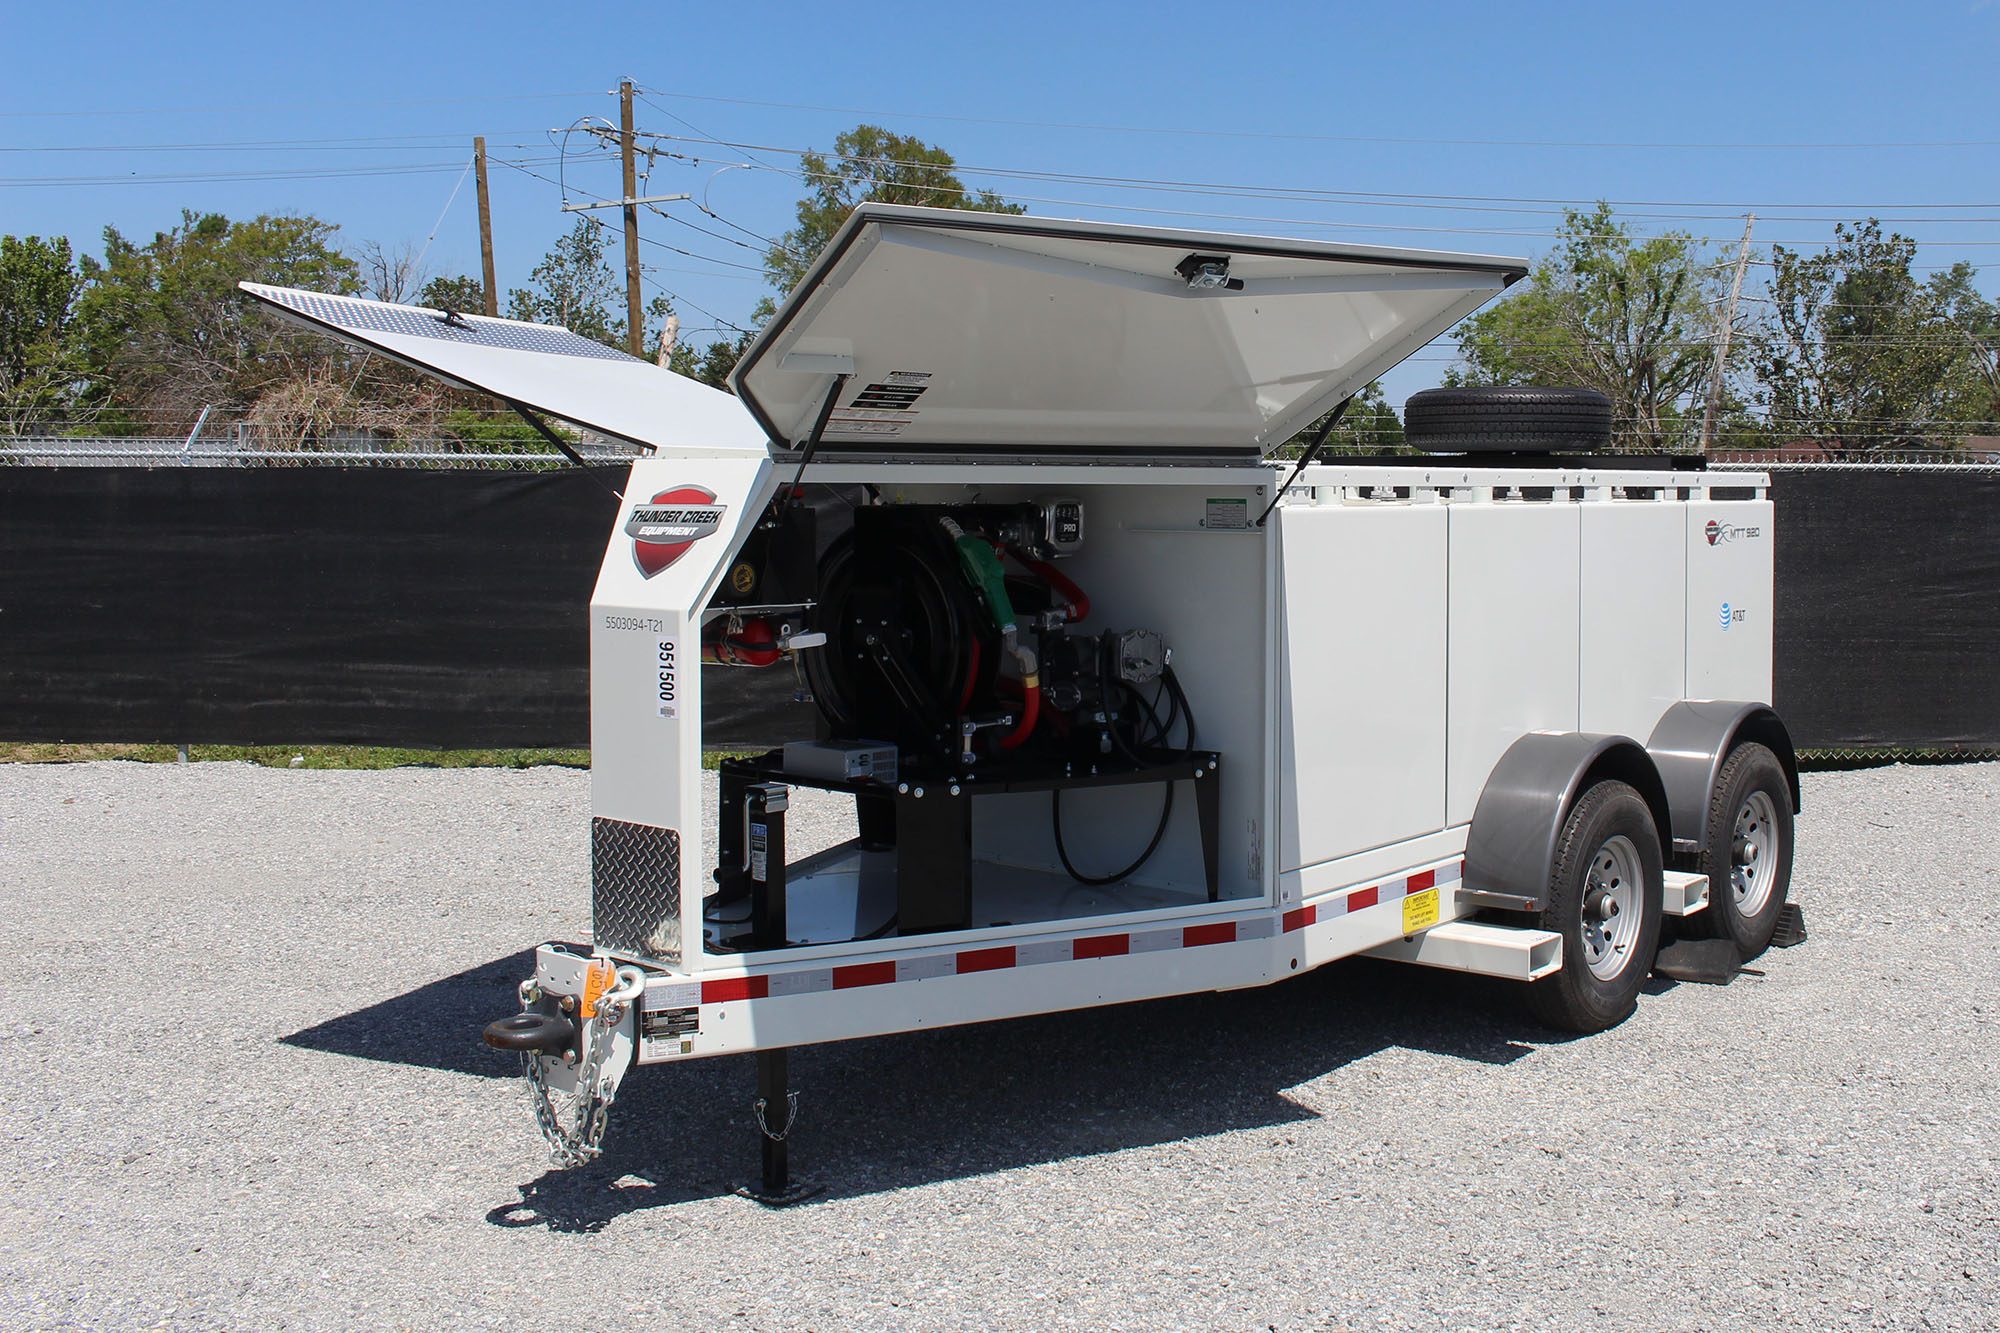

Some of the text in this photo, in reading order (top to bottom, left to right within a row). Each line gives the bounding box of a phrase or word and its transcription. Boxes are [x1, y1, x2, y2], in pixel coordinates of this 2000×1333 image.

[630, 510, 722, 524] THUNDER CREEK
[638, 526, 699, 537] EQUIPMENT
[1063, 523, 1076, 532] PRO
[1730, 528, 1745, 539] MTT
[1732, 609, 1746, 622] AT&T
[605, 616, 663, 632] 5503094-T21
[659, 641, 675, 702] 951500
